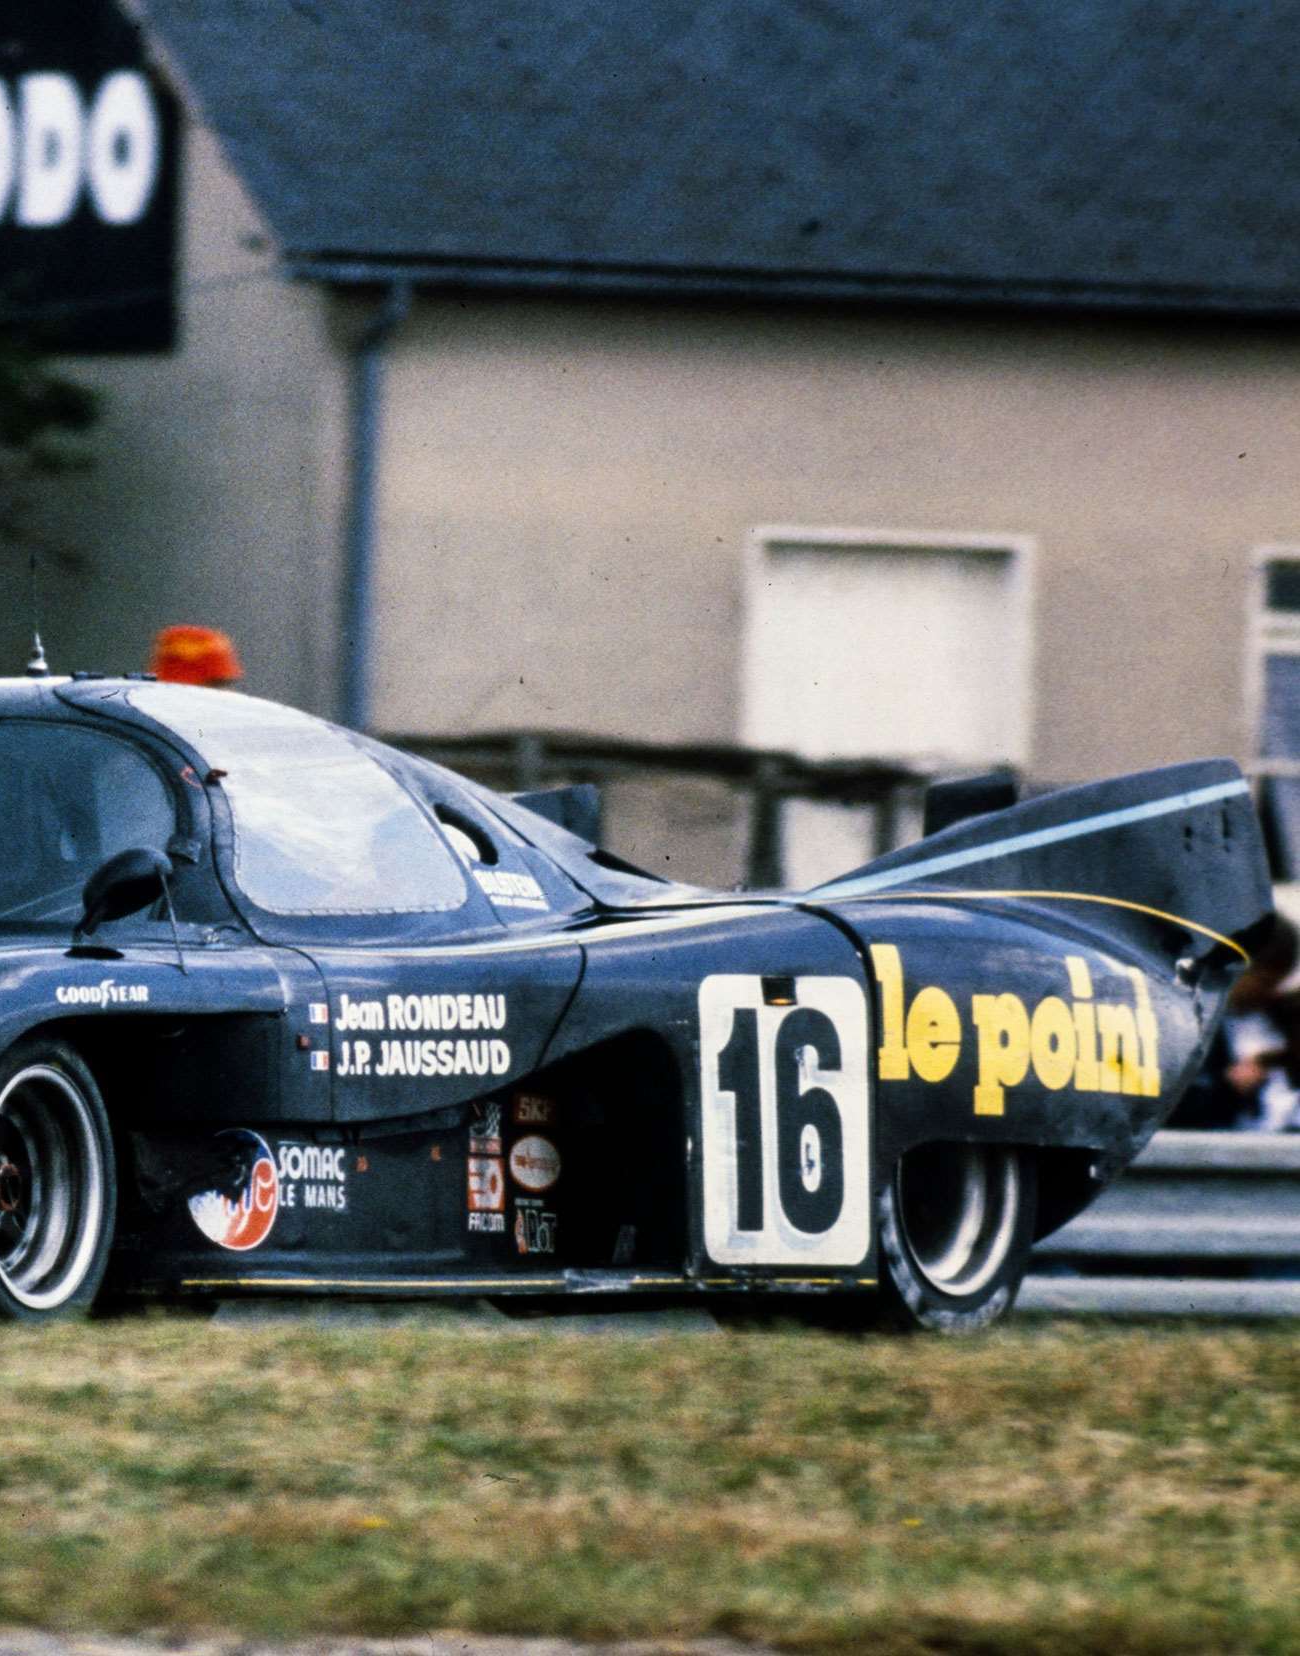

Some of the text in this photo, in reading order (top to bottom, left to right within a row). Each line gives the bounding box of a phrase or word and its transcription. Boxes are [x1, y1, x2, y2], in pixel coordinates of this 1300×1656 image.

[56, 980, 149, 1009] GOODYEAR
[335, 994, 506, 1031] Jean RONDEAU
[870, 944, 1160, 1116] le point
[336, 1041, 510, 1076] J.P. JAUSSAUD
[718, 1008, 845, 1235] 16
[278, 1147, 346, 1182] SOMAC
[279, 1185, 346, 1209] LE MANS
